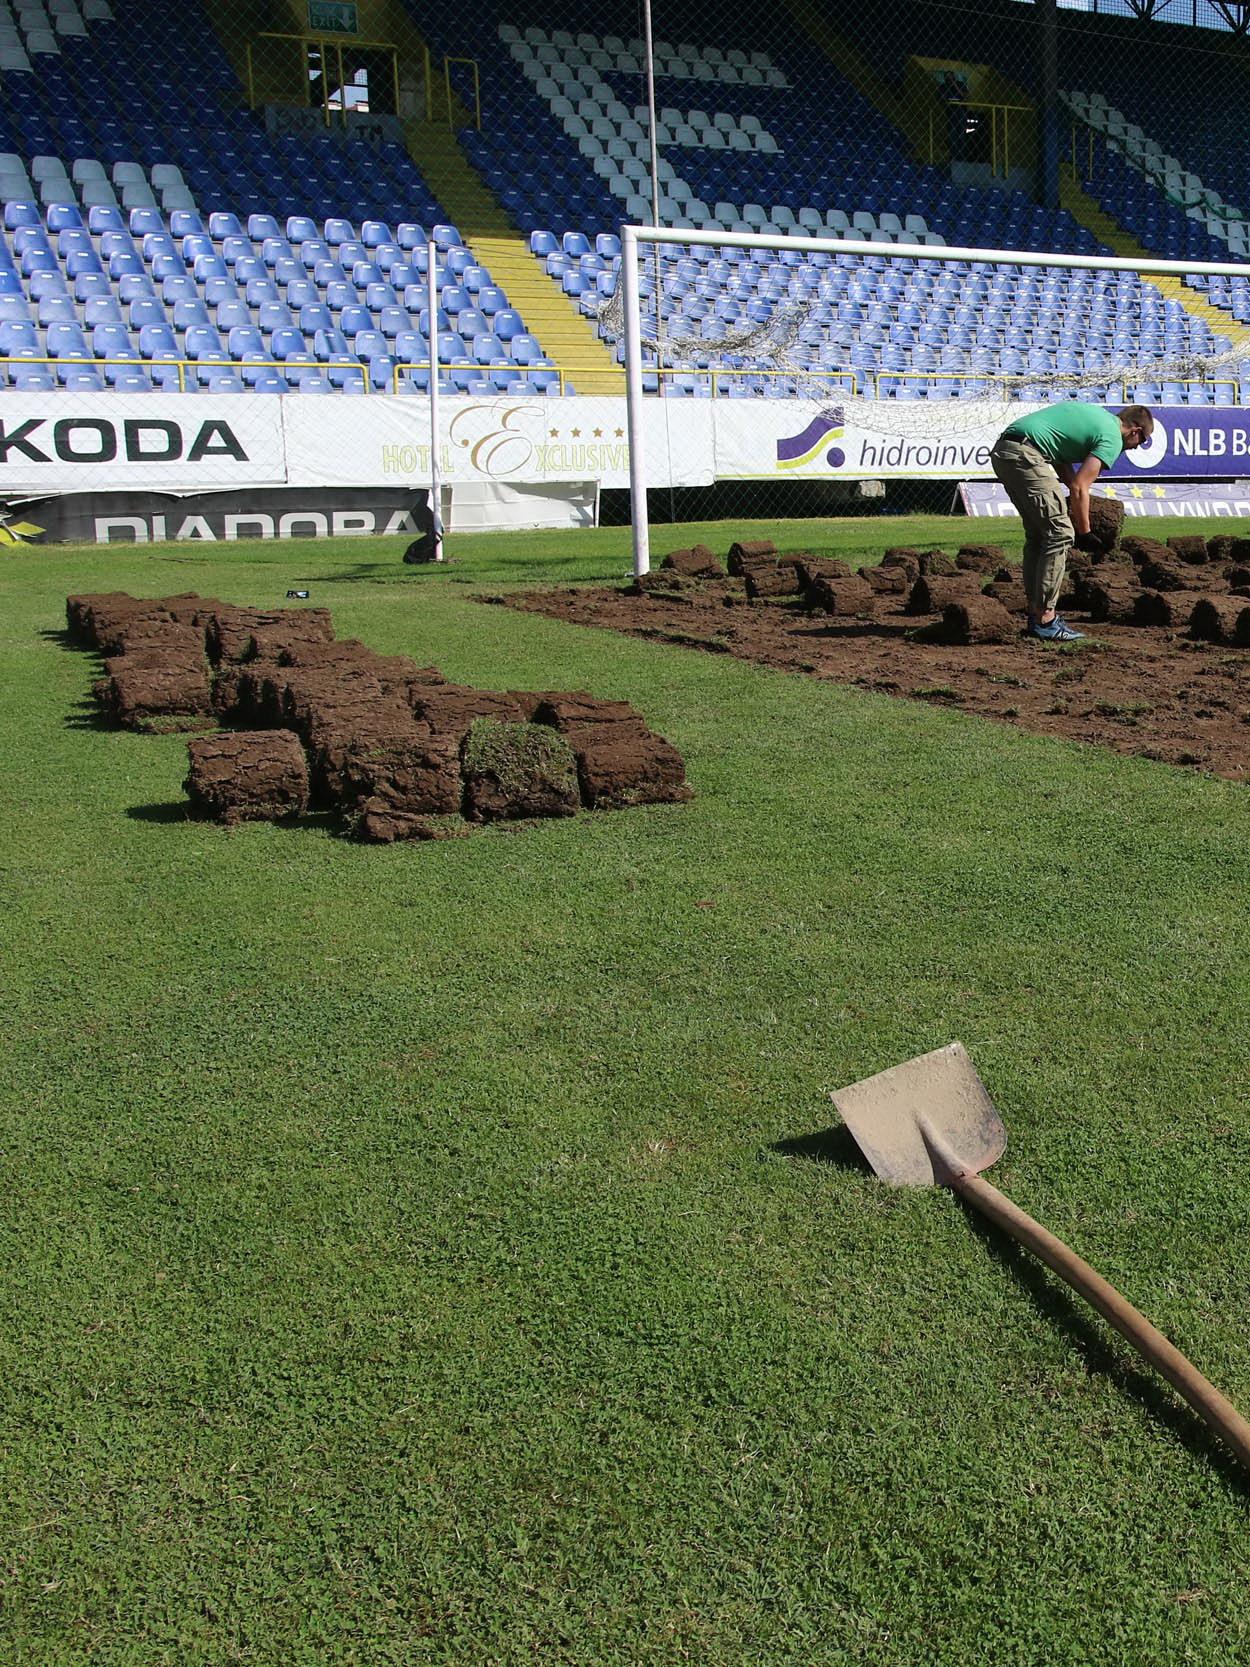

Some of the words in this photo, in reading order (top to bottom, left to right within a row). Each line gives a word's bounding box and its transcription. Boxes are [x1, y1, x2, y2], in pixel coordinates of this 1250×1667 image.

[0, 418, 250, 463] KODA
[1174, 428, 1226, 456] NLB
[382, 444, 455, 475] HOTL
